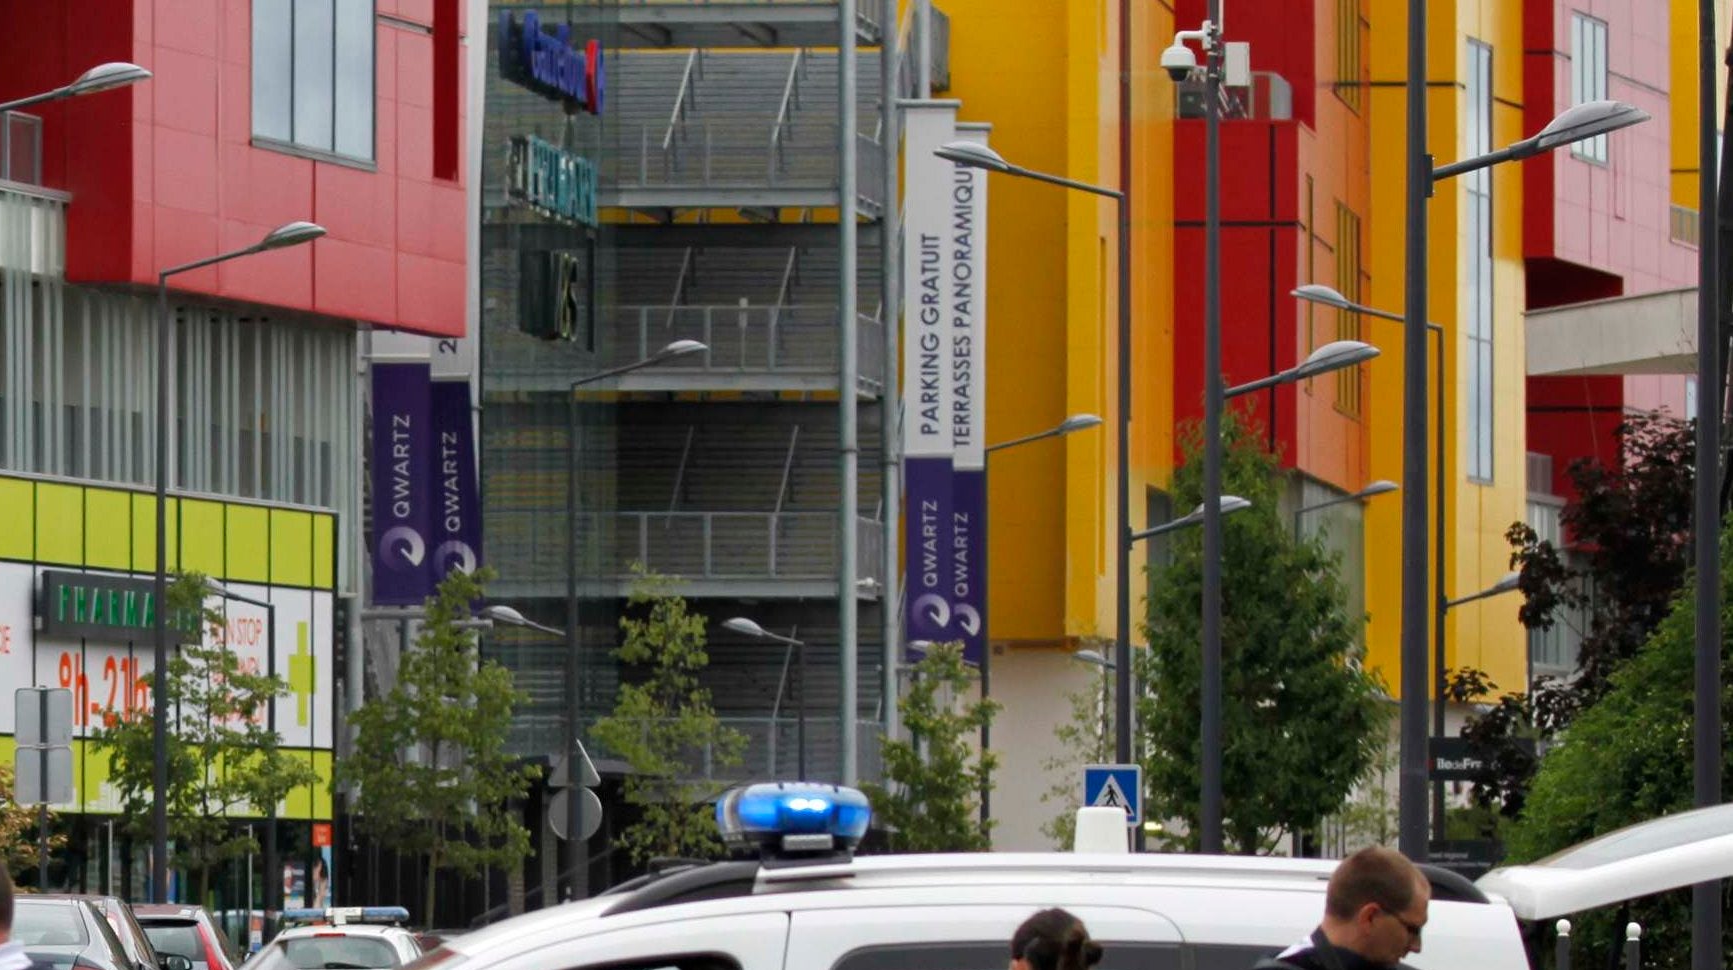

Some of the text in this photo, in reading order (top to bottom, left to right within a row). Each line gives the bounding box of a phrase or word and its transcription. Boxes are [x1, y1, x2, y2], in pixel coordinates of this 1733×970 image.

[920, 233, 940, 435] PARKING GRATUIT
[953, 335, 971, 449] TERRASSES
[393, 414, 411, 518] QWARTZ
[442, 431, 461, 532] QWARTZ
[922, 500, 938, 587] QWARTZ
[954, 512, 969, 597] QWARTZ
